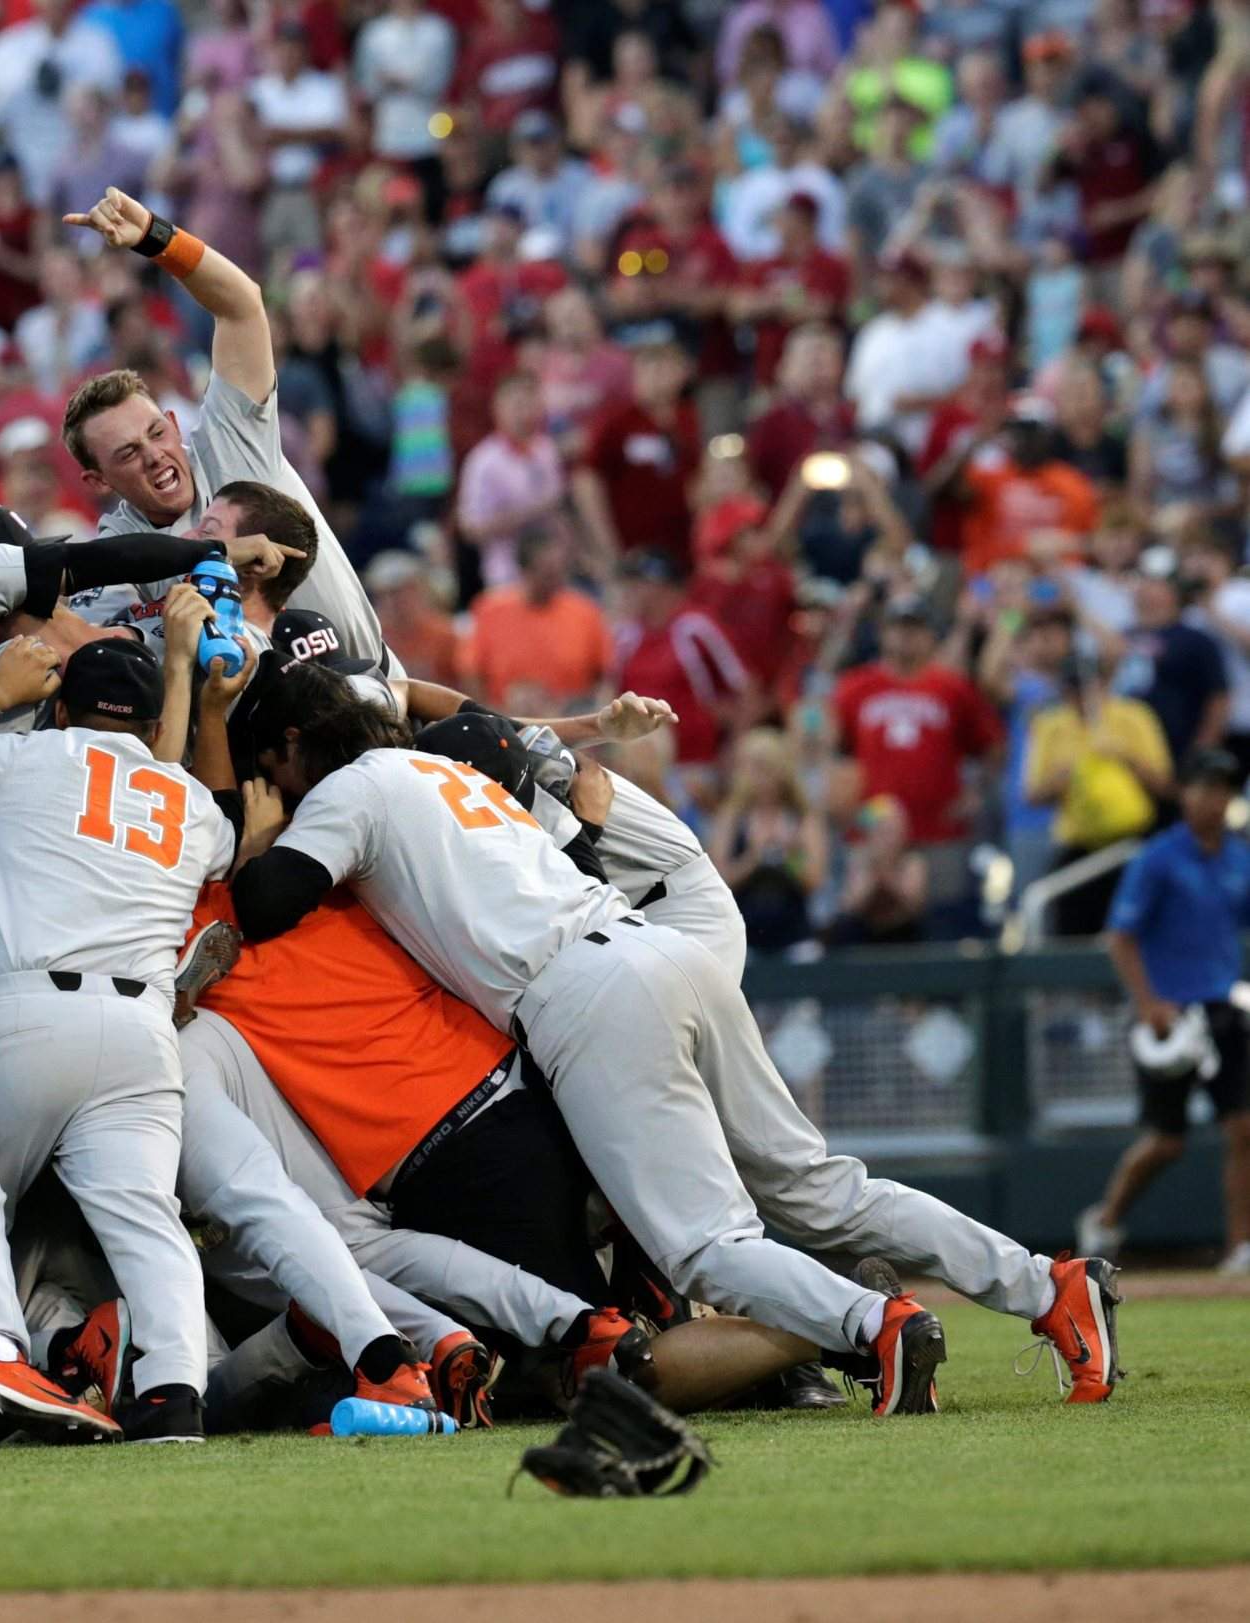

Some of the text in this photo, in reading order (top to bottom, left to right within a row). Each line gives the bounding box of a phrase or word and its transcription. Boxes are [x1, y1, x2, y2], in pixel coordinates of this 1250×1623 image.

[290, 627, 339, 661] OSU
[74, 743, 190, 871] 13
[406, 758, 544, 833] 22
